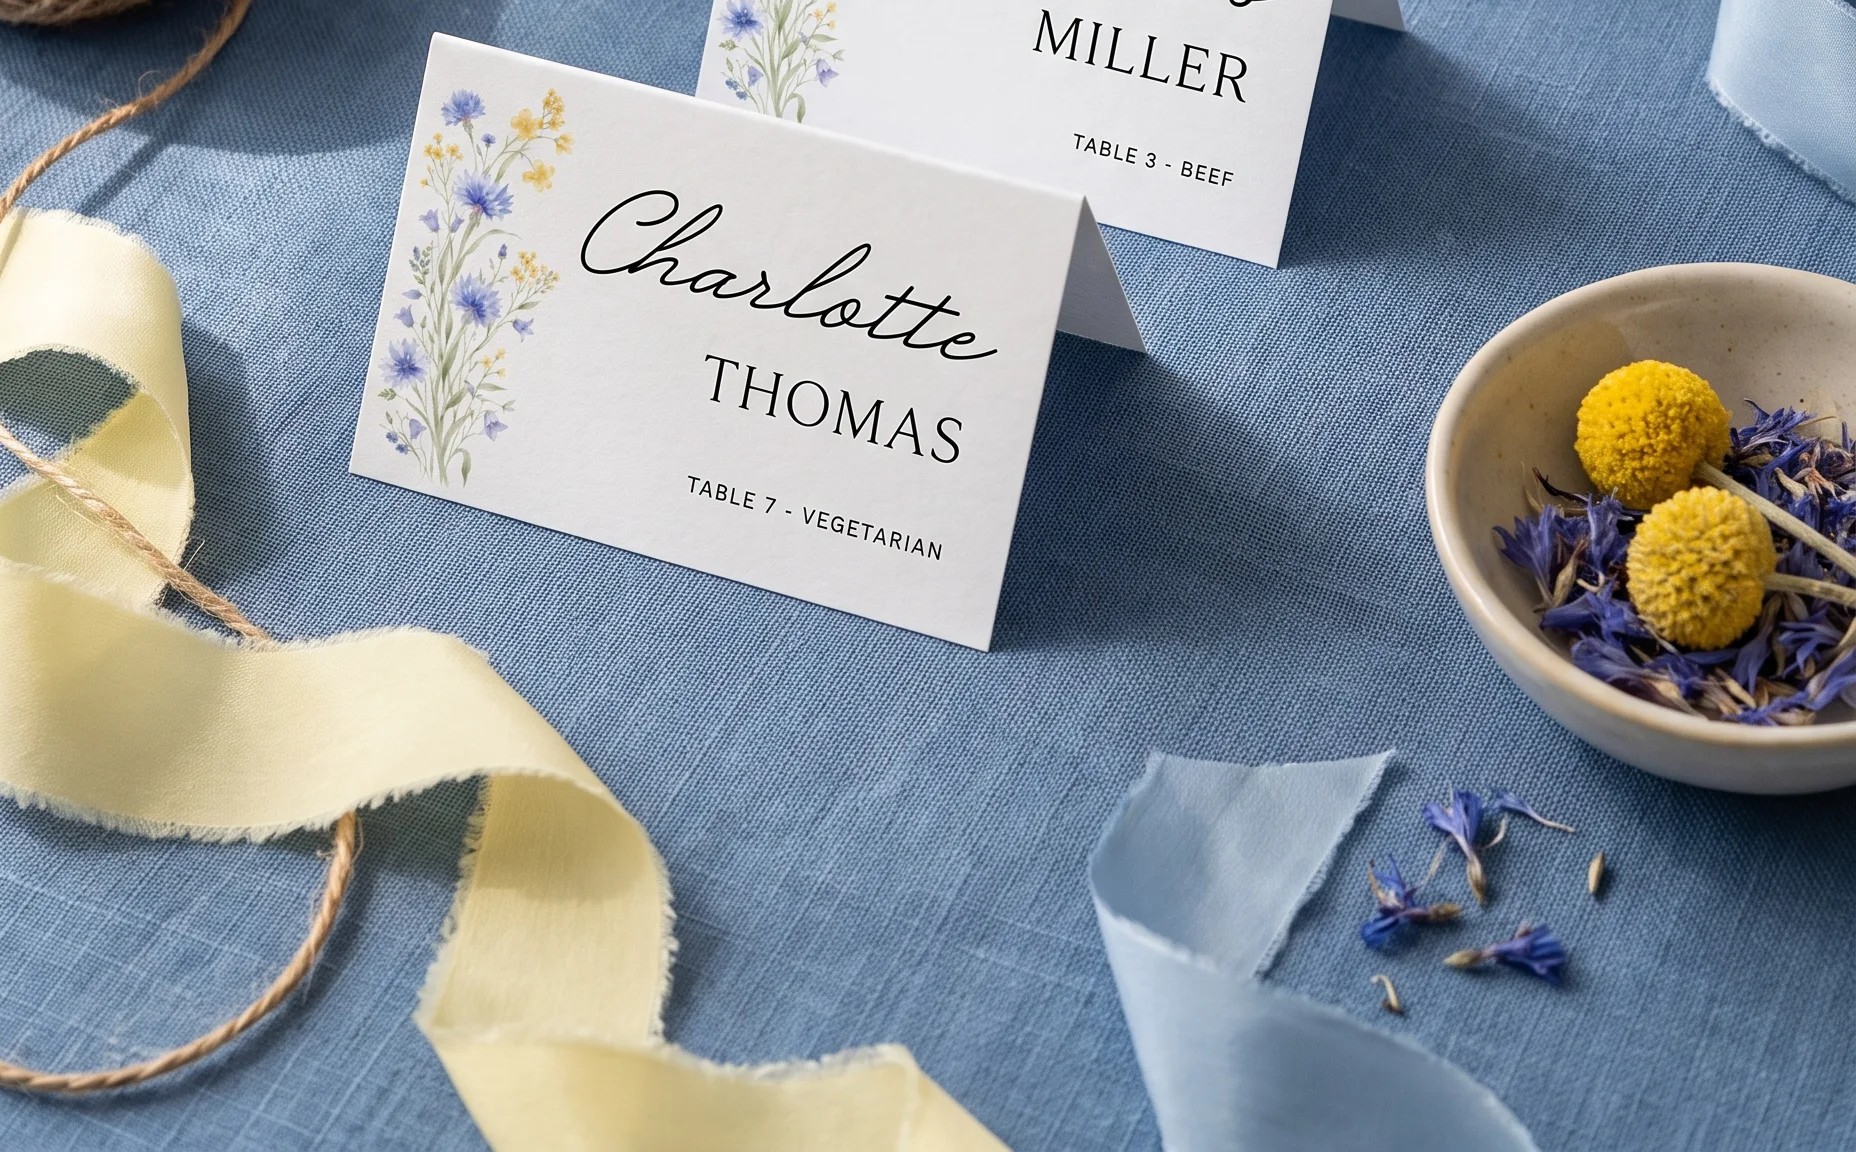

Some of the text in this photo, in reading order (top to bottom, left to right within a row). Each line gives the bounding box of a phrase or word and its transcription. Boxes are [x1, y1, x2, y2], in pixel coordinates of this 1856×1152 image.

[1032, 8, 1249, 104] MILLER
[1073, 133, 1138, 165] TABLE
[1145, 152, 1157, 169] 3
[1180, 160, 1234, 187] BEEF
[580, 189, 999, 361] Charlotte
[704, 354, 964, 465] THOMAS
[687, 475, 756, 510] TABLE
[765, 496, 777, 514] 7
[803, 506, 943, 561] VEGETARIAN
